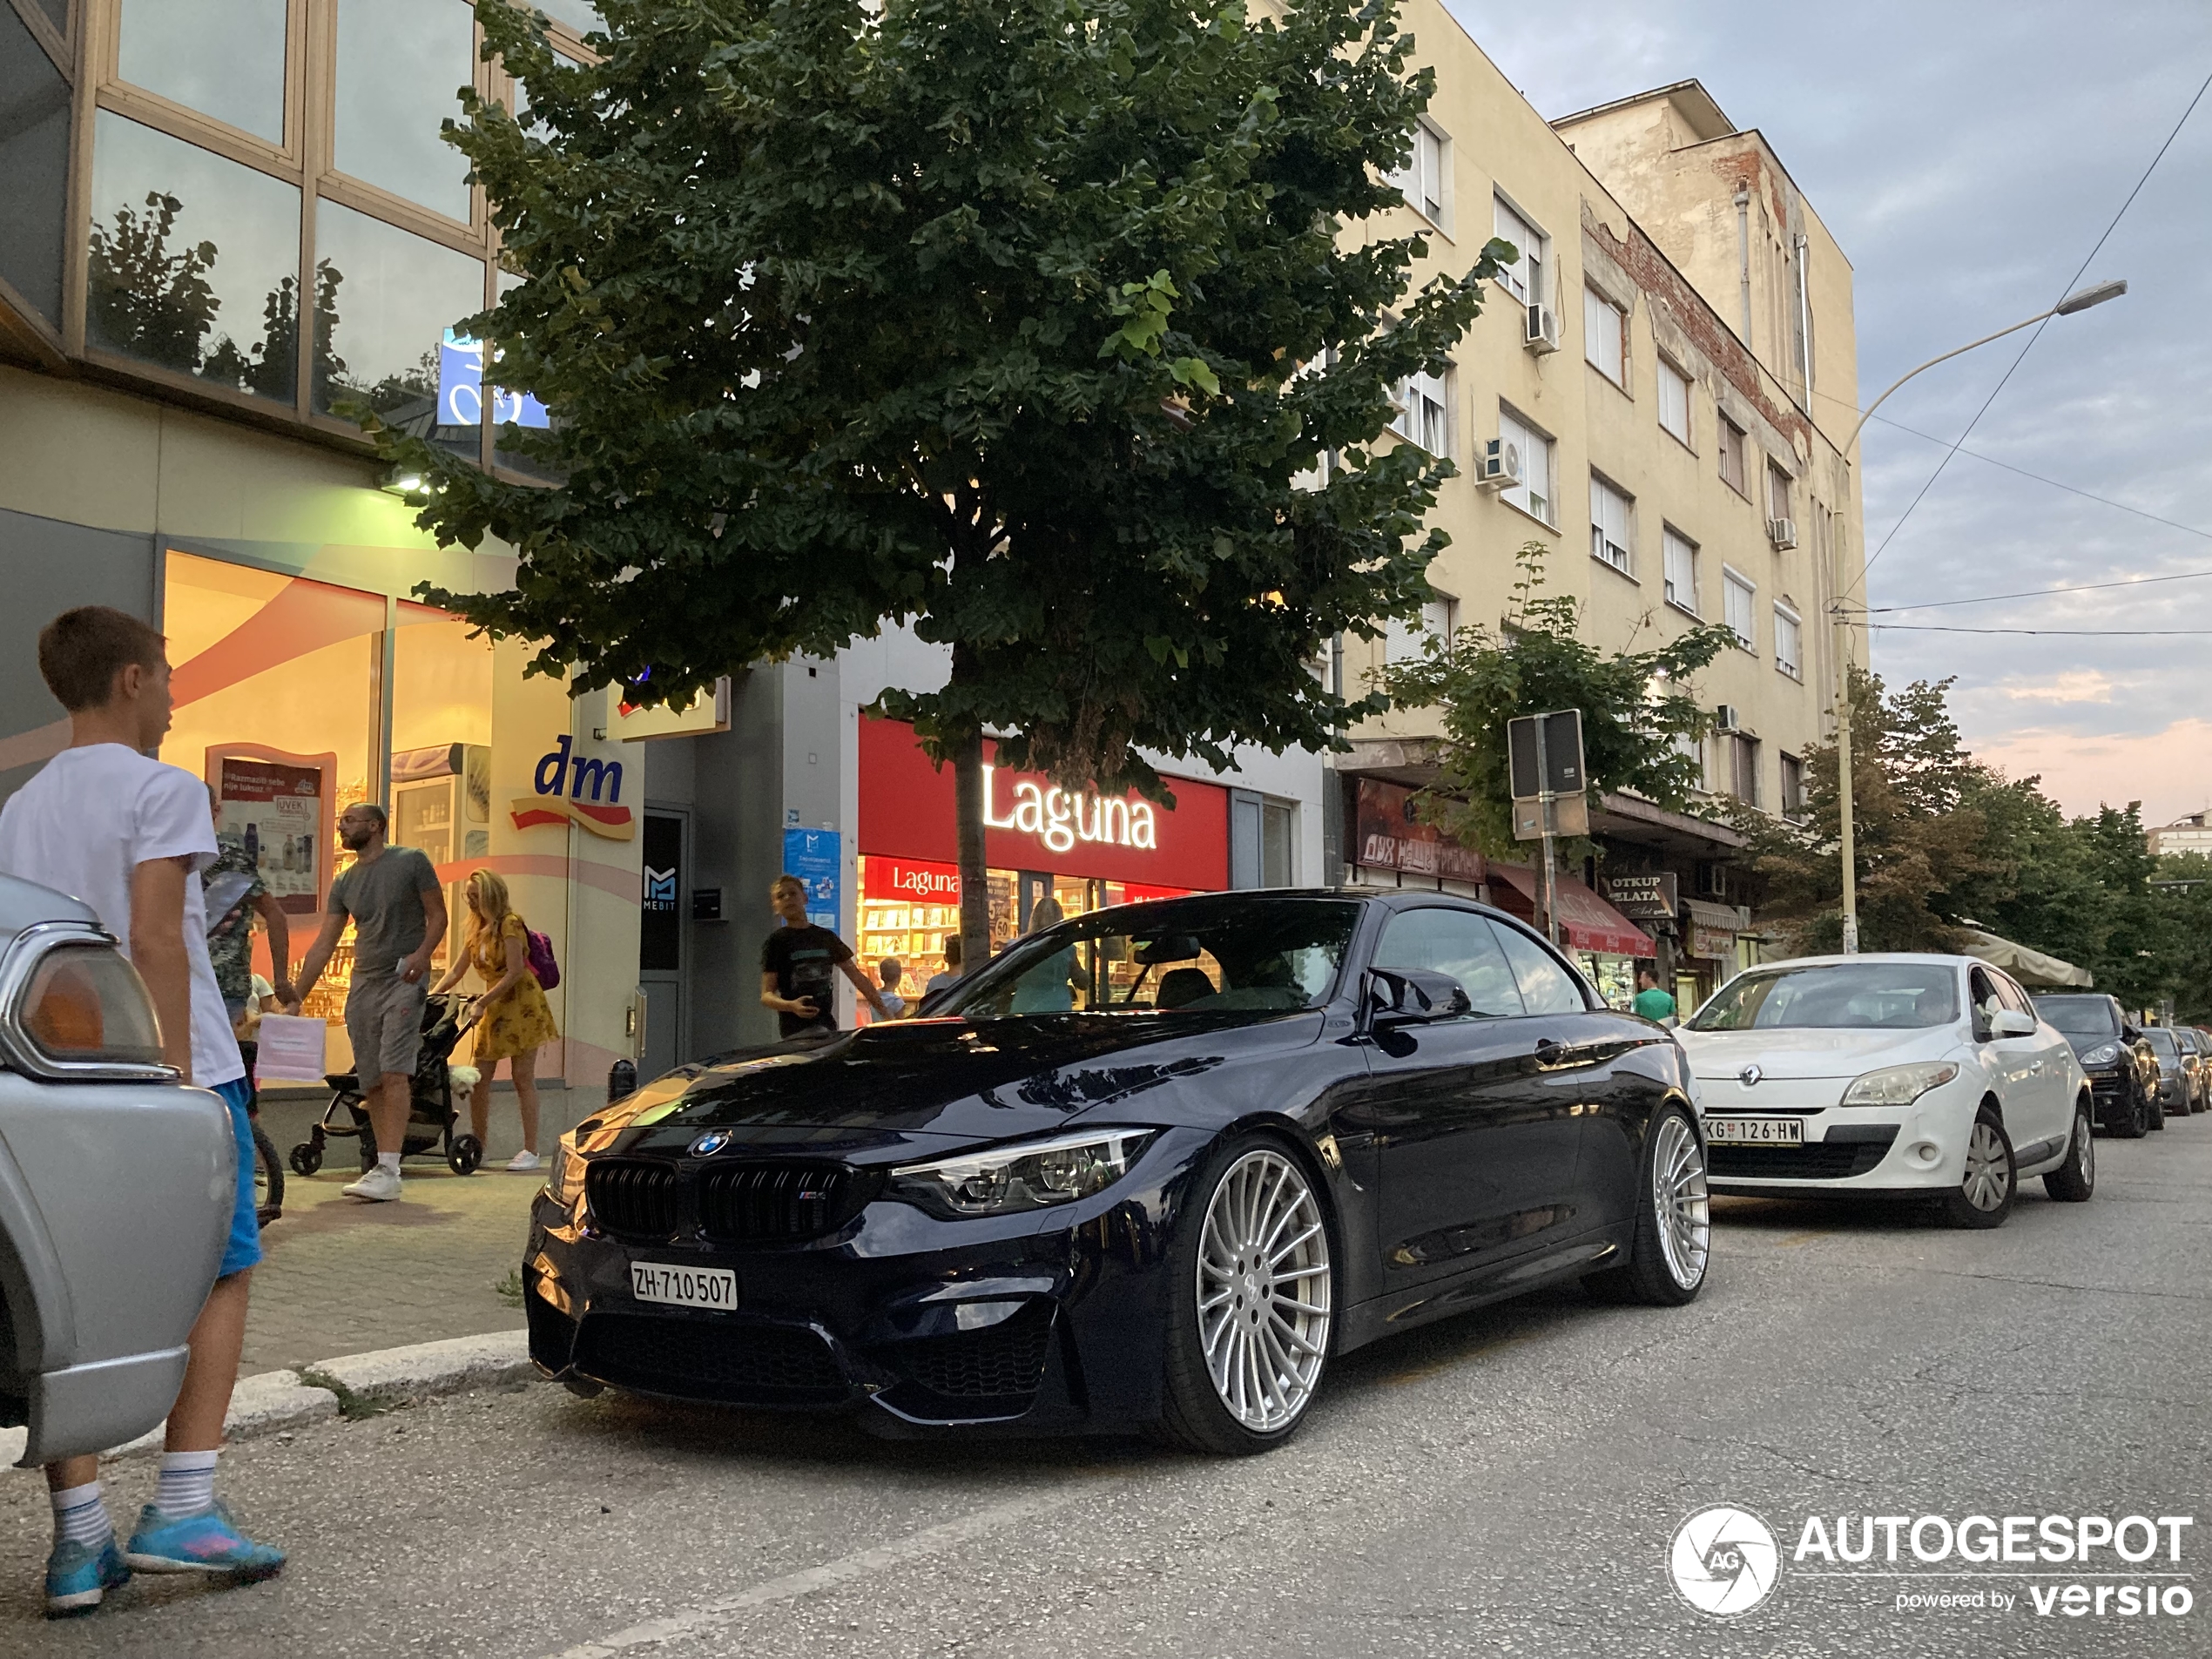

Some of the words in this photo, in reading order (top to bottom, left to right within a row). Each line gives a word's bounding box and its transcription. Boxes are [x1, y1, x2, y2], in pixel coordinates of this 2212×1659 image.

[535, 734, 623, 803] dm
[279, 800, 303, 810] UVEK
[982, 765, 1157, 852] Laguna
[894, 867, 959, 895] Laguna
[1612, 877, 1661, 887] OTKUP
[644, 900, 675, 911] MEBIT
[1707, 1122, 1725, 1138] KG
